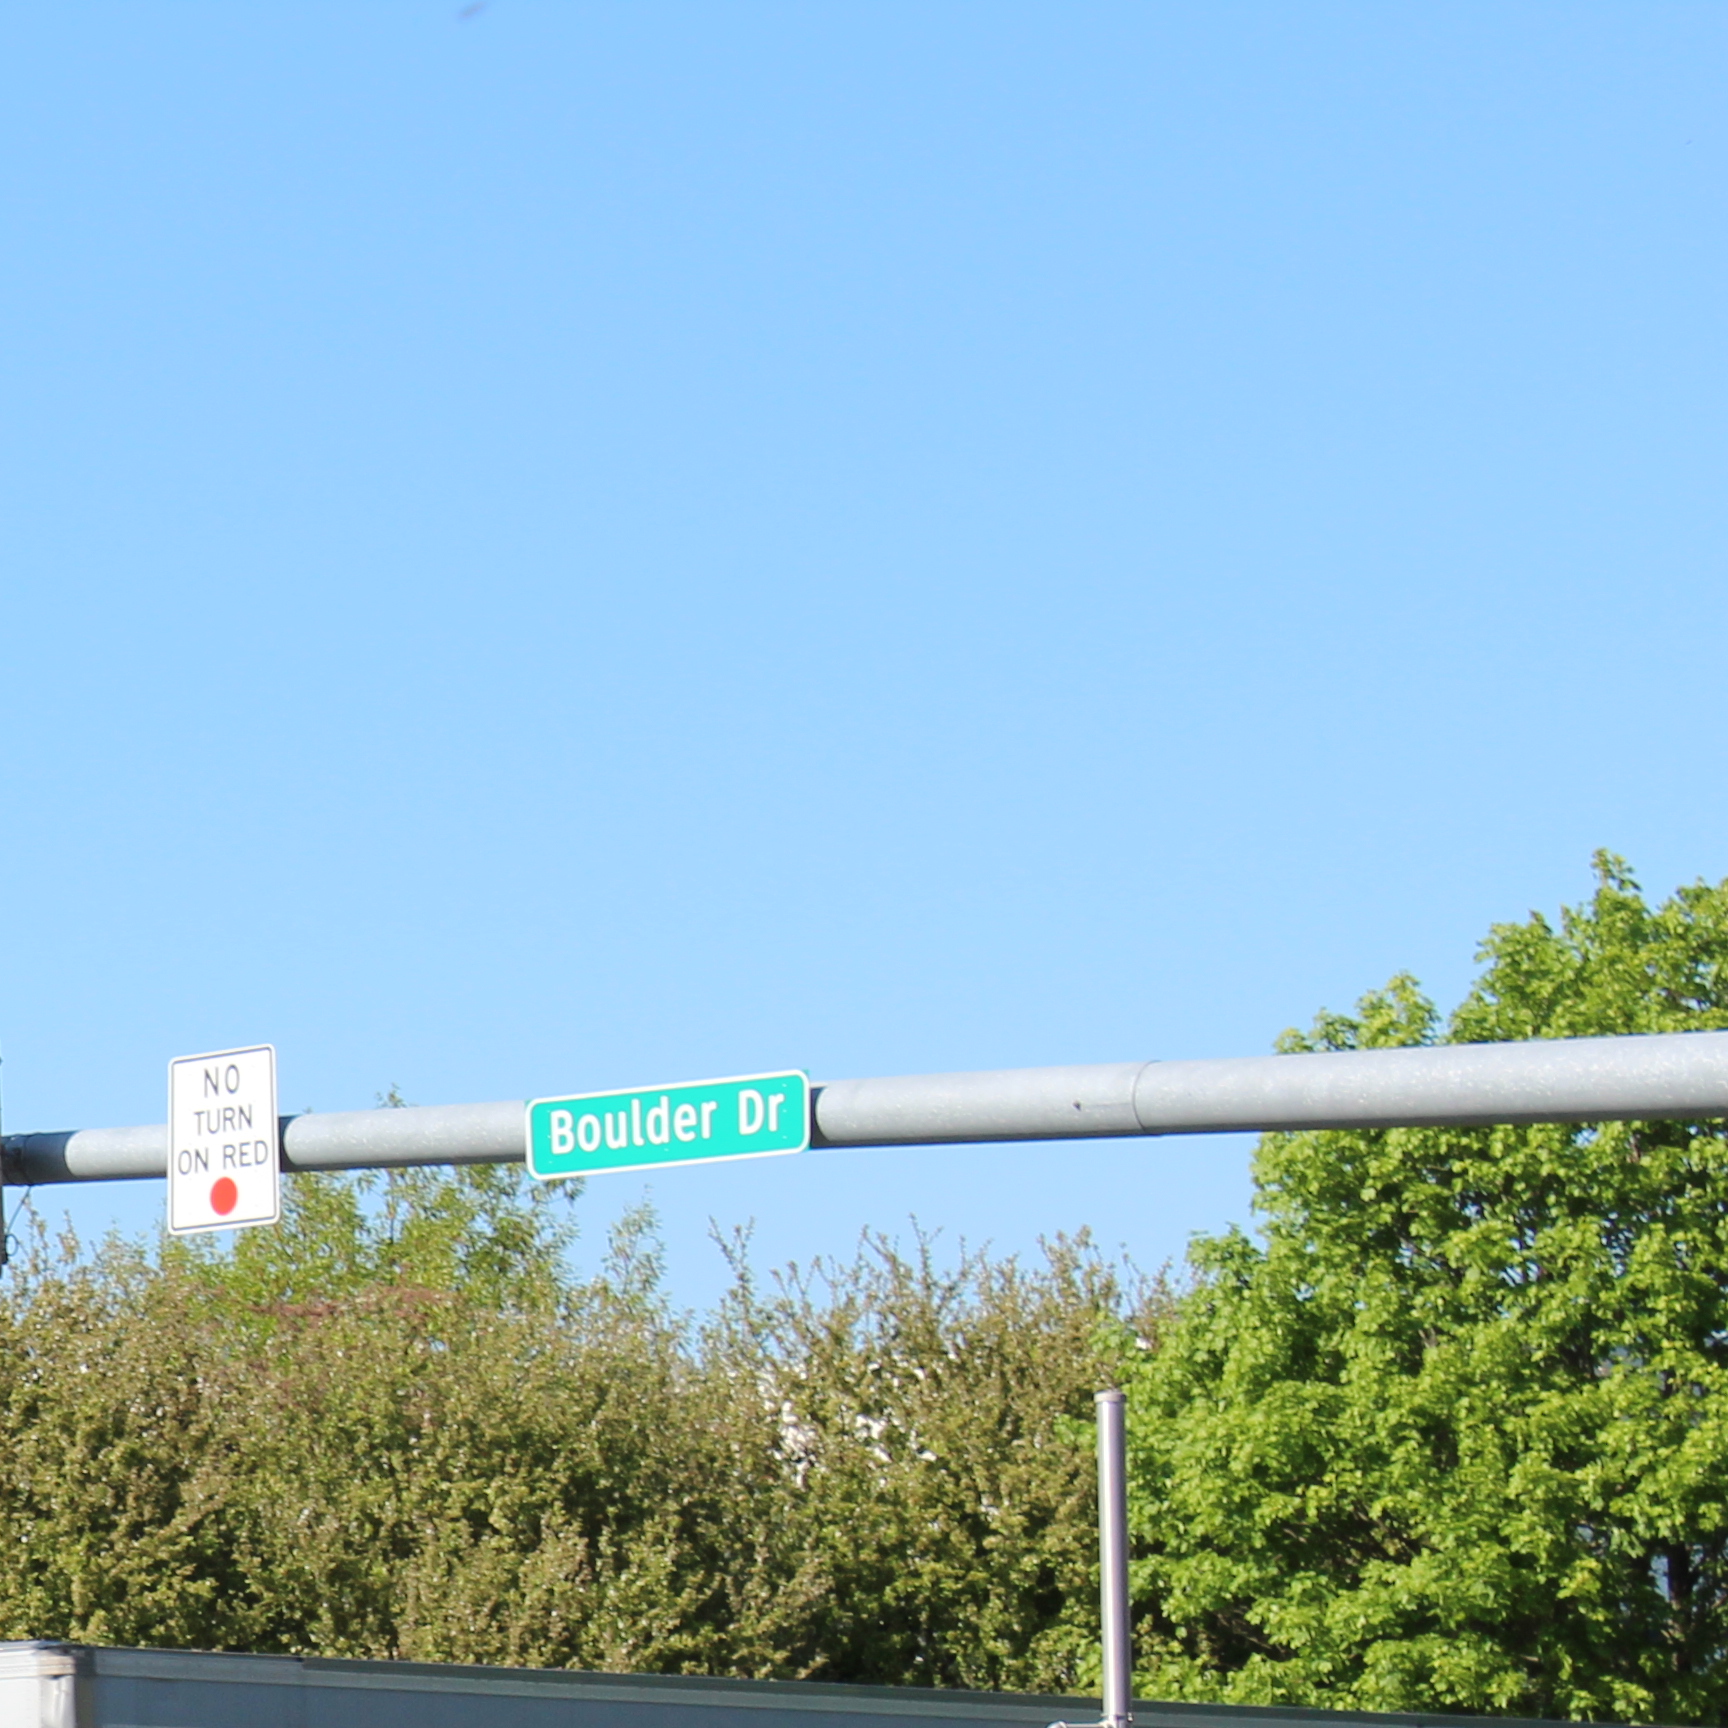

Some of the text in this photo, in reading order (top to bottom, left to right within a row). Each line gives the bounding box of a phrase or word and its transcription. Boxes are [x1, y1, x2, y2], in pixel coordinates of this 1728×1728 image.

[204, 1064, 240, 1098] NO
[194, 1104, 253, 1136] TURN
[550, 1089, 785, 1155] Boulder Dr
[178, 1140, 268, 1176] ON RED
